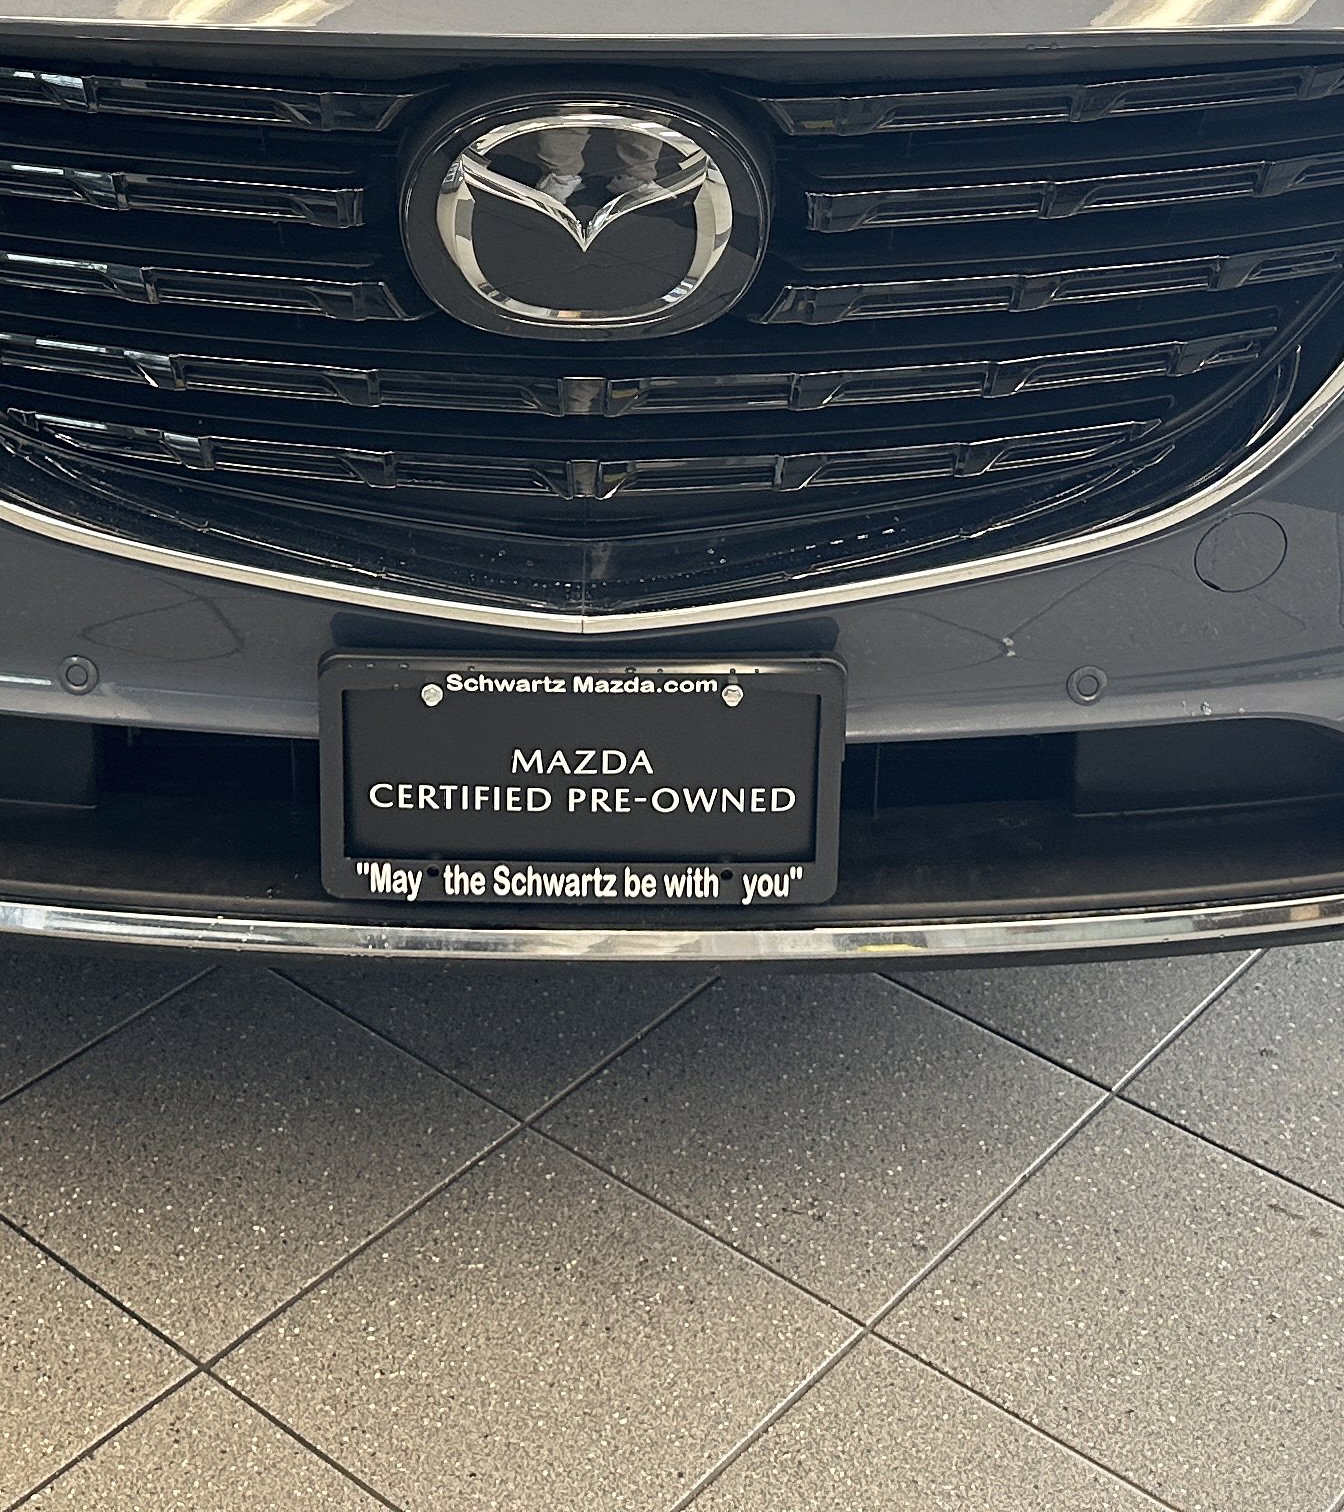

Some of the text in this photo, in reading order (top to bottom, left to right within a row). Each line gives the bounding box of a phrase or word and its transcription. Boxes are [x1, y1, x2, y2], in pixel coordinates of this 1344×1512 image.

[446, 673, 718, 694] Schwartz Mazda.com
[511, 748, 654, 775] MAZDA
[369, 783, 796, 813] CERTIFIED PRE-OWNED
[356, 861, 803, 905] "May the Schwartz be with you"
